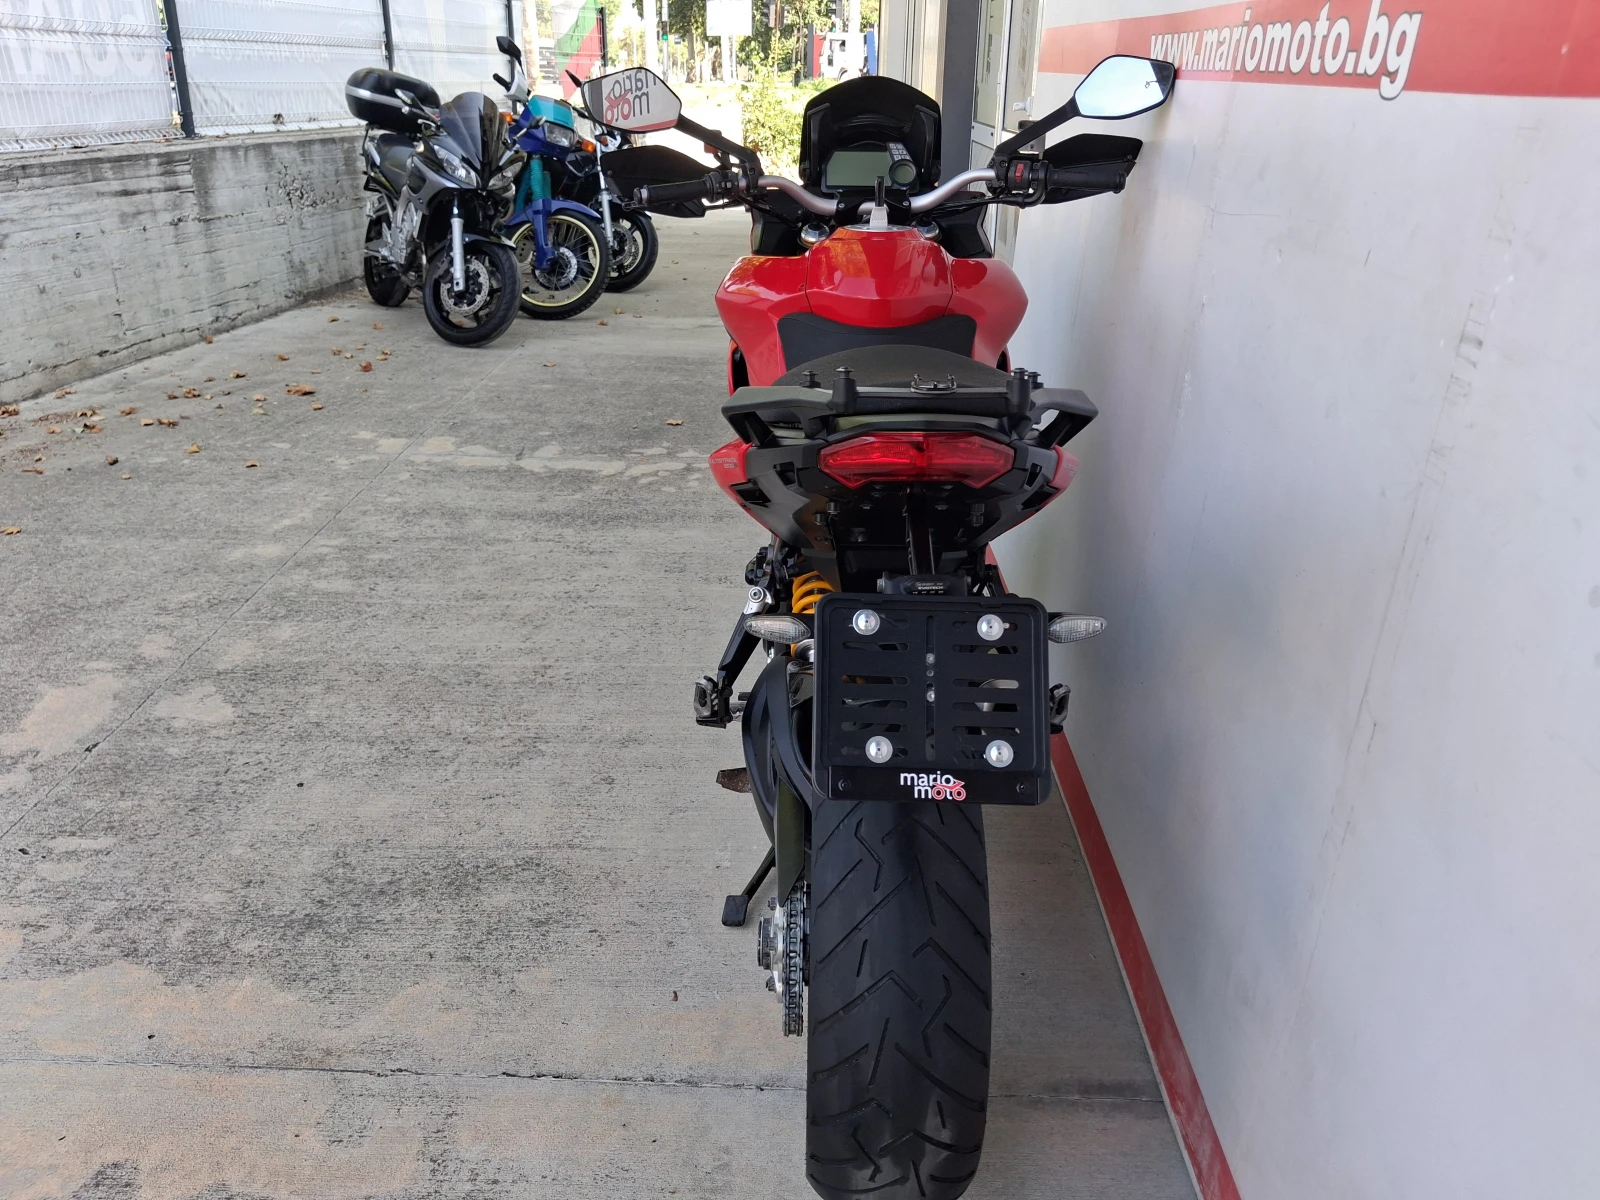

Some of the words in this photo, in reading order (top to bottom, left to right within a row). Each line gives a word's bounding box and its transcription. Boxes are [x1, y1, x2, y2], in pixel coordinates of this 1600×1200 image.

[1150, 0, 1424, 100] www.mariomoto.bg
[900, 770, 954, 786] mario
[914, 785, 967, 801] moto
